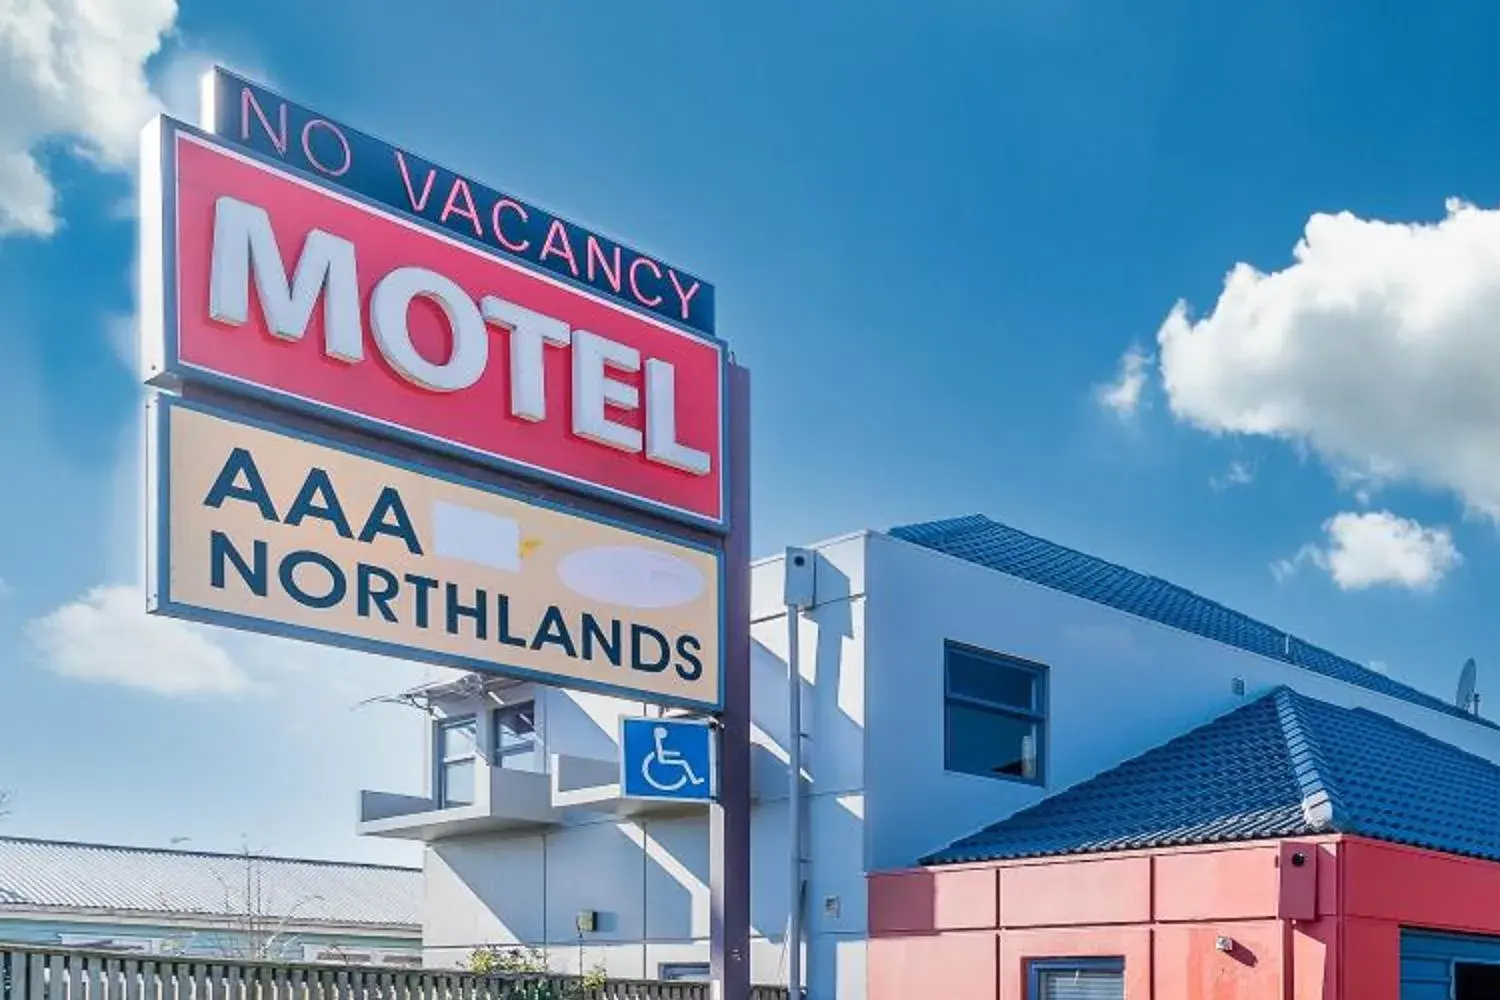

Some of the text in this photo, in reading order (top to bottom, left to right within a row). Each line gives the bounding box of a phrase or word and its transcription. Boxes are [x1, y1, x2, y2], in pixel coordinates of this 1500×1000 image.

[241, 87, 700, 319] NO VACANCY
[209, 195, 711, 476] MOTEL
[203, 446, 424, 556] AAA
[210, 530, 703, 681] NORTHLANDS
